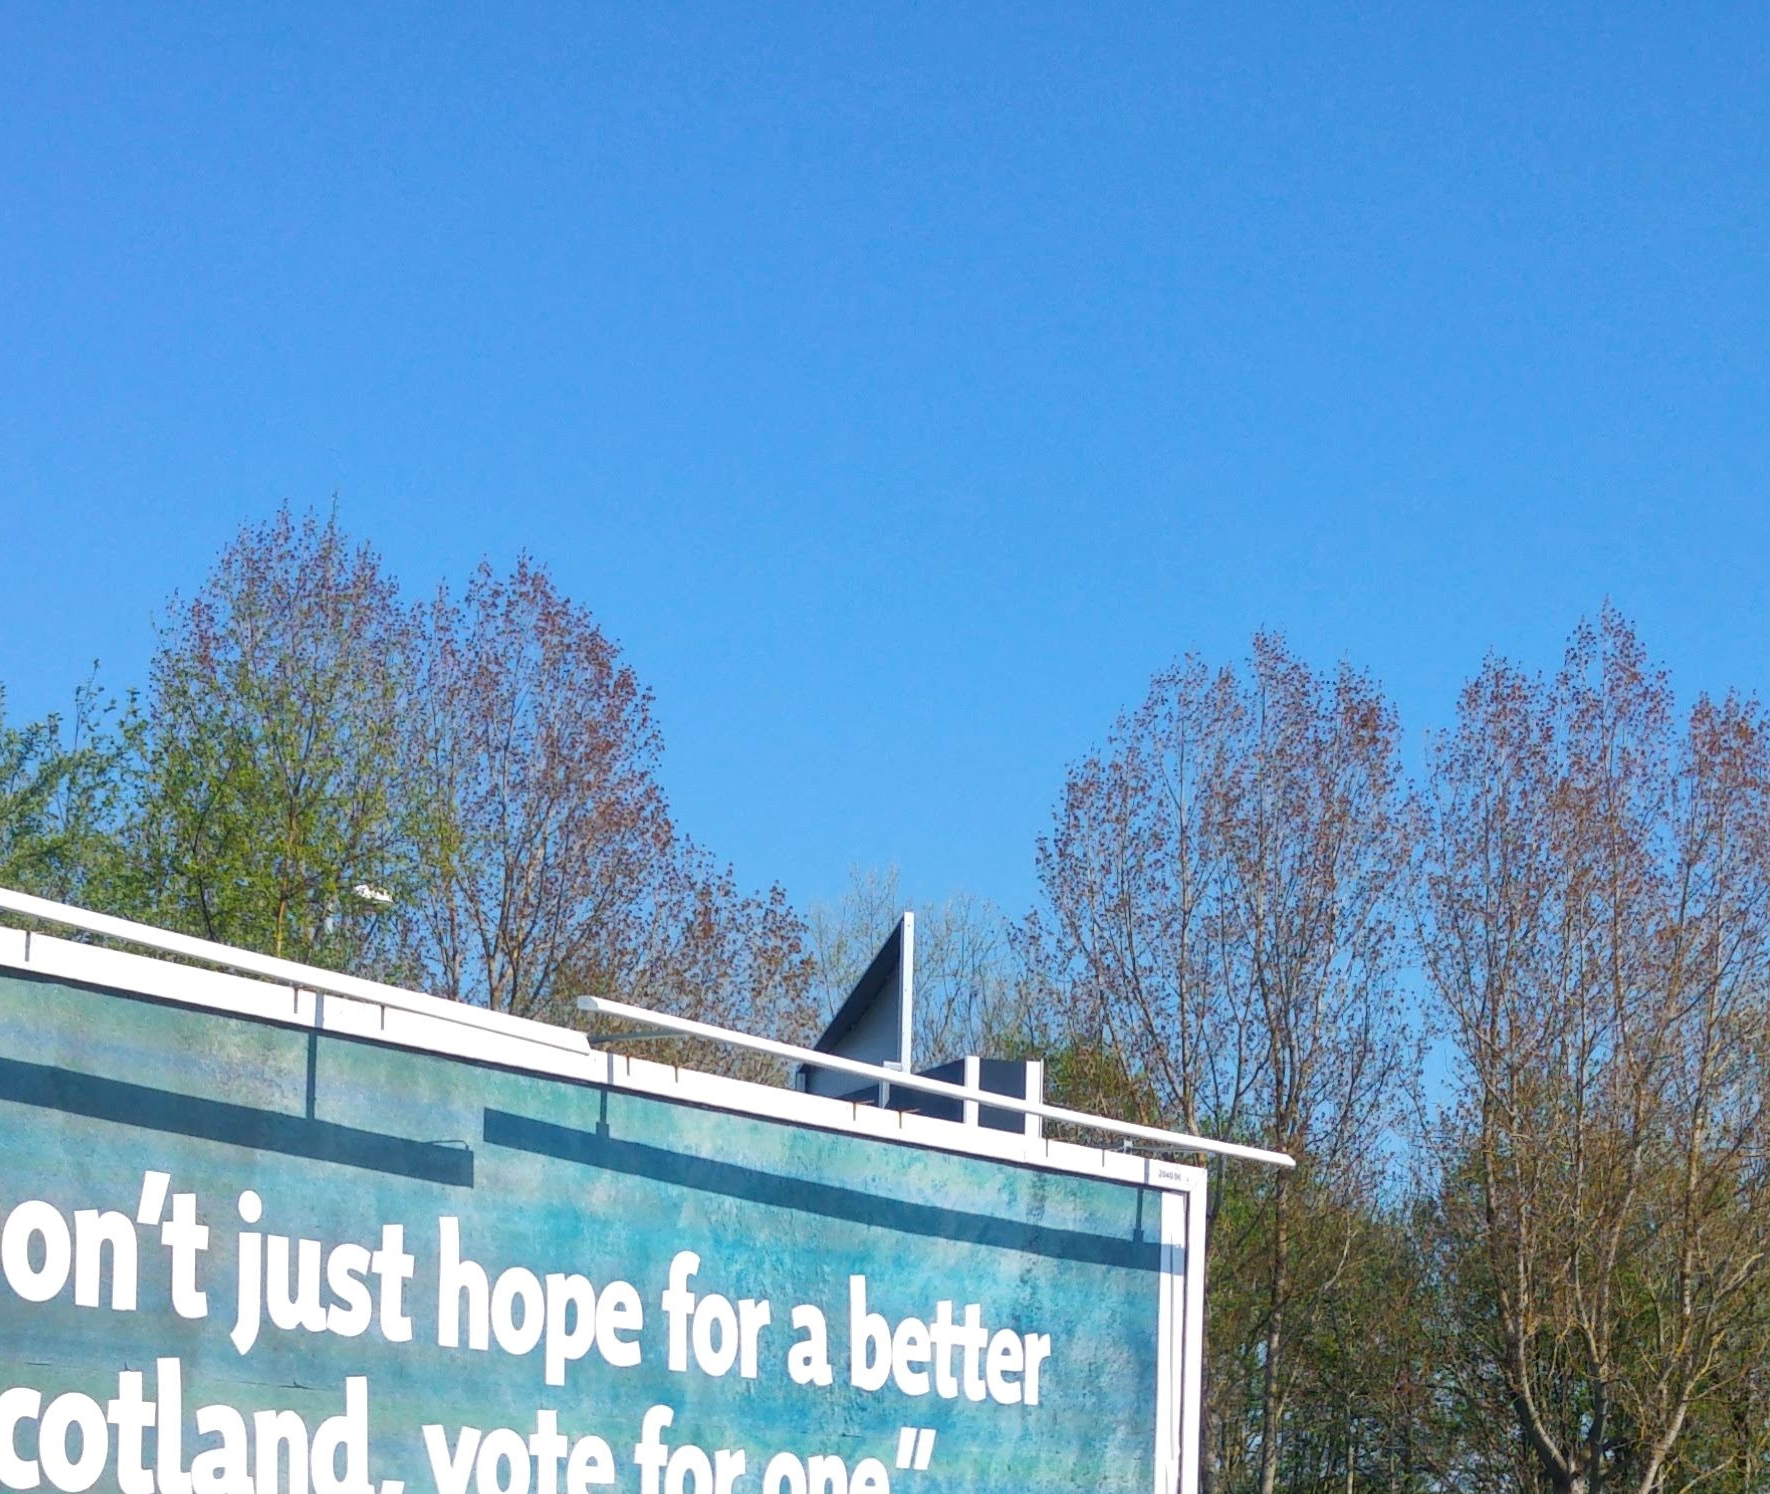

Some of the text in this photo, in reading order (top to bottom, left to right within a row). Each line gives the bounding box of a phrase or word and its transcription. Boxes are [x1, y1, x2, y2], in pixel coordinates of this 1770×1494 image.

[230, 1190, 415, 1355] just
[438, 1216, 643, 1386] hope
[661, 1250, 771, 1379] for
[788, 1304, 833, 1386] a
[849, 1275, 1051, 1406] better
